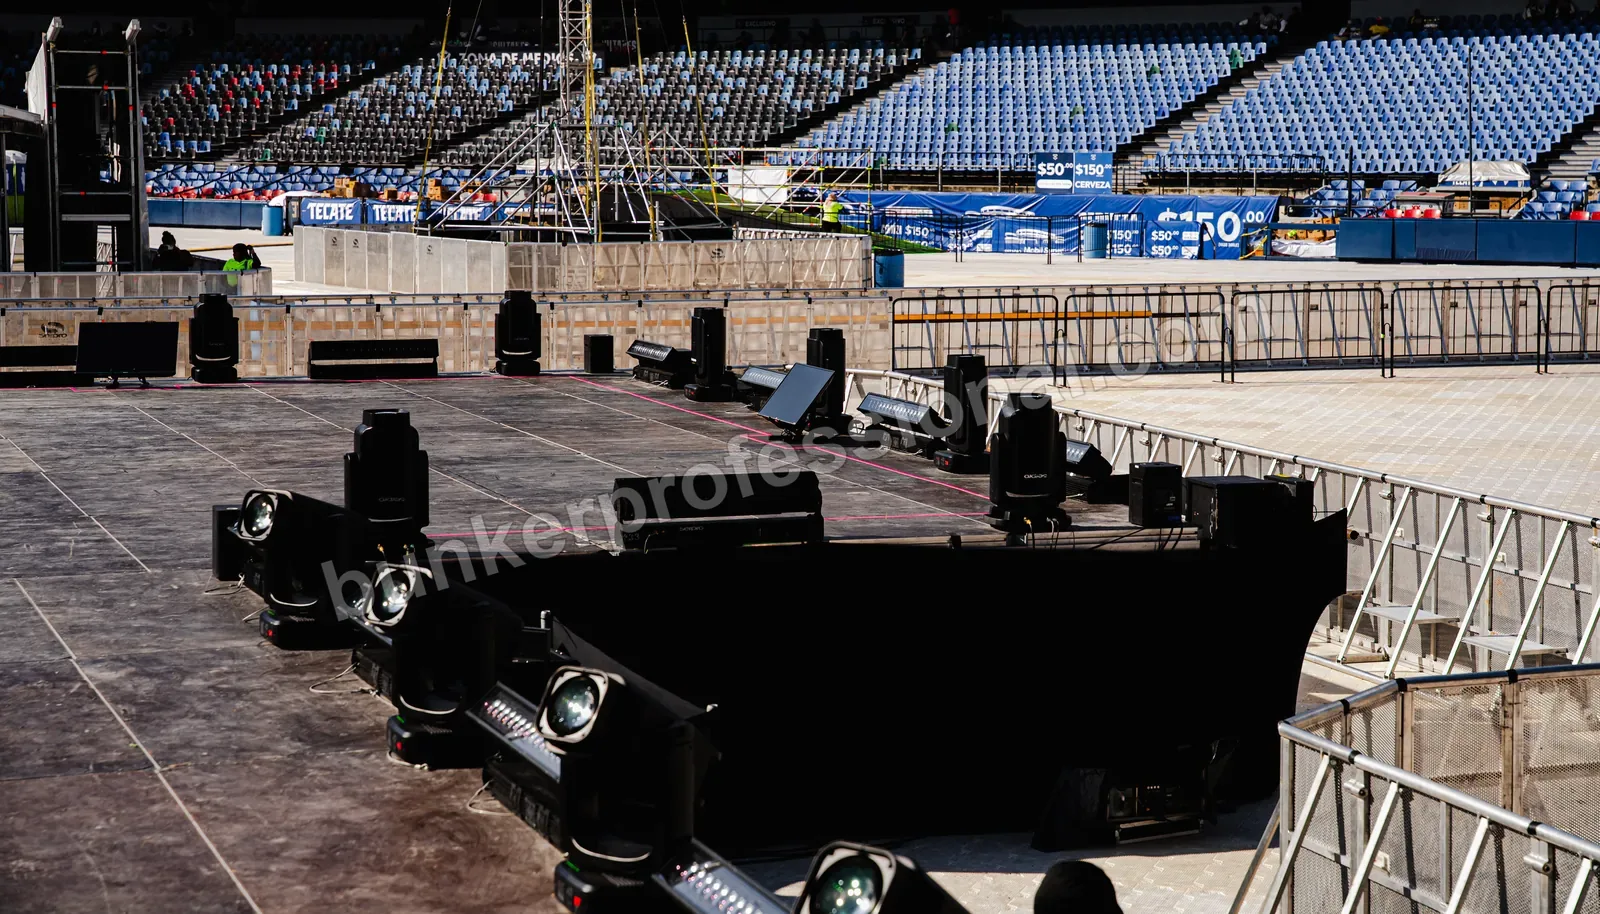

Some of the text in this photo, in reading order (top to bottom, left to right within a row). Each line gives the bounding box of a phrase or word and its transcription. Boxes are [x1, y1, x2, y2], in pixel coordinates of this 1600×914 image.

[502, 53, 519, 64] DE
[306, 203, 354, 220] TECATE
[372, 205, 417, 222] TECATE
